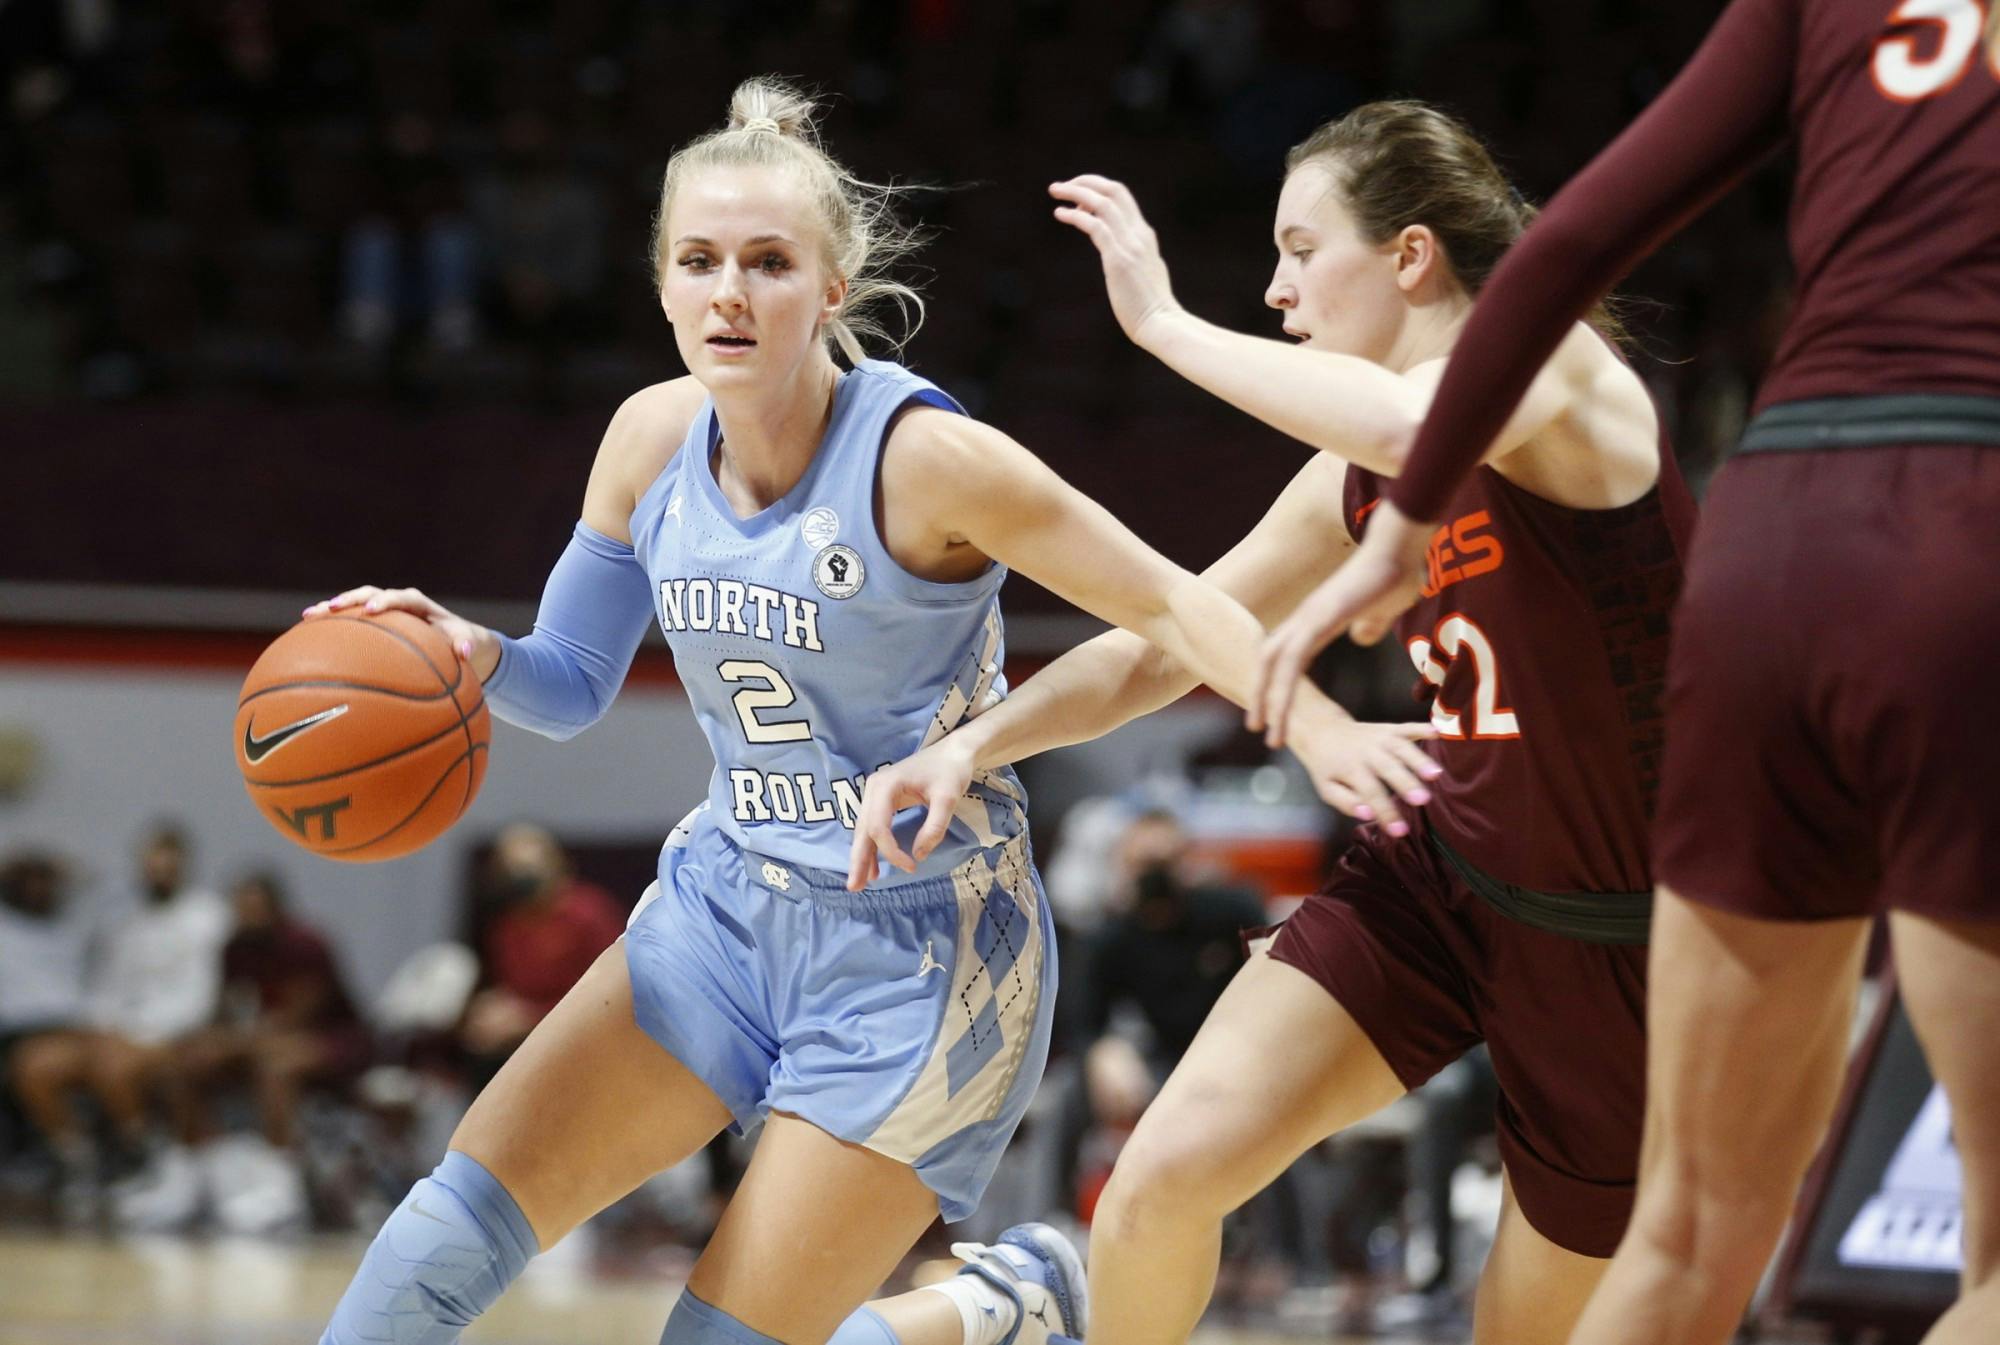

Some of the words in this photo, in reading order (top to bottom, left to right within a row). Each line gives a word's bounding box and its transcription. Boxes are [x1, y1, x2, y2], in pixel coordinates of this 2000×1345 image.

[1870, 0, 2000, 104] 3
[659, 578, 825, 653] NORTH
[716, 659, 813, 744] 2
